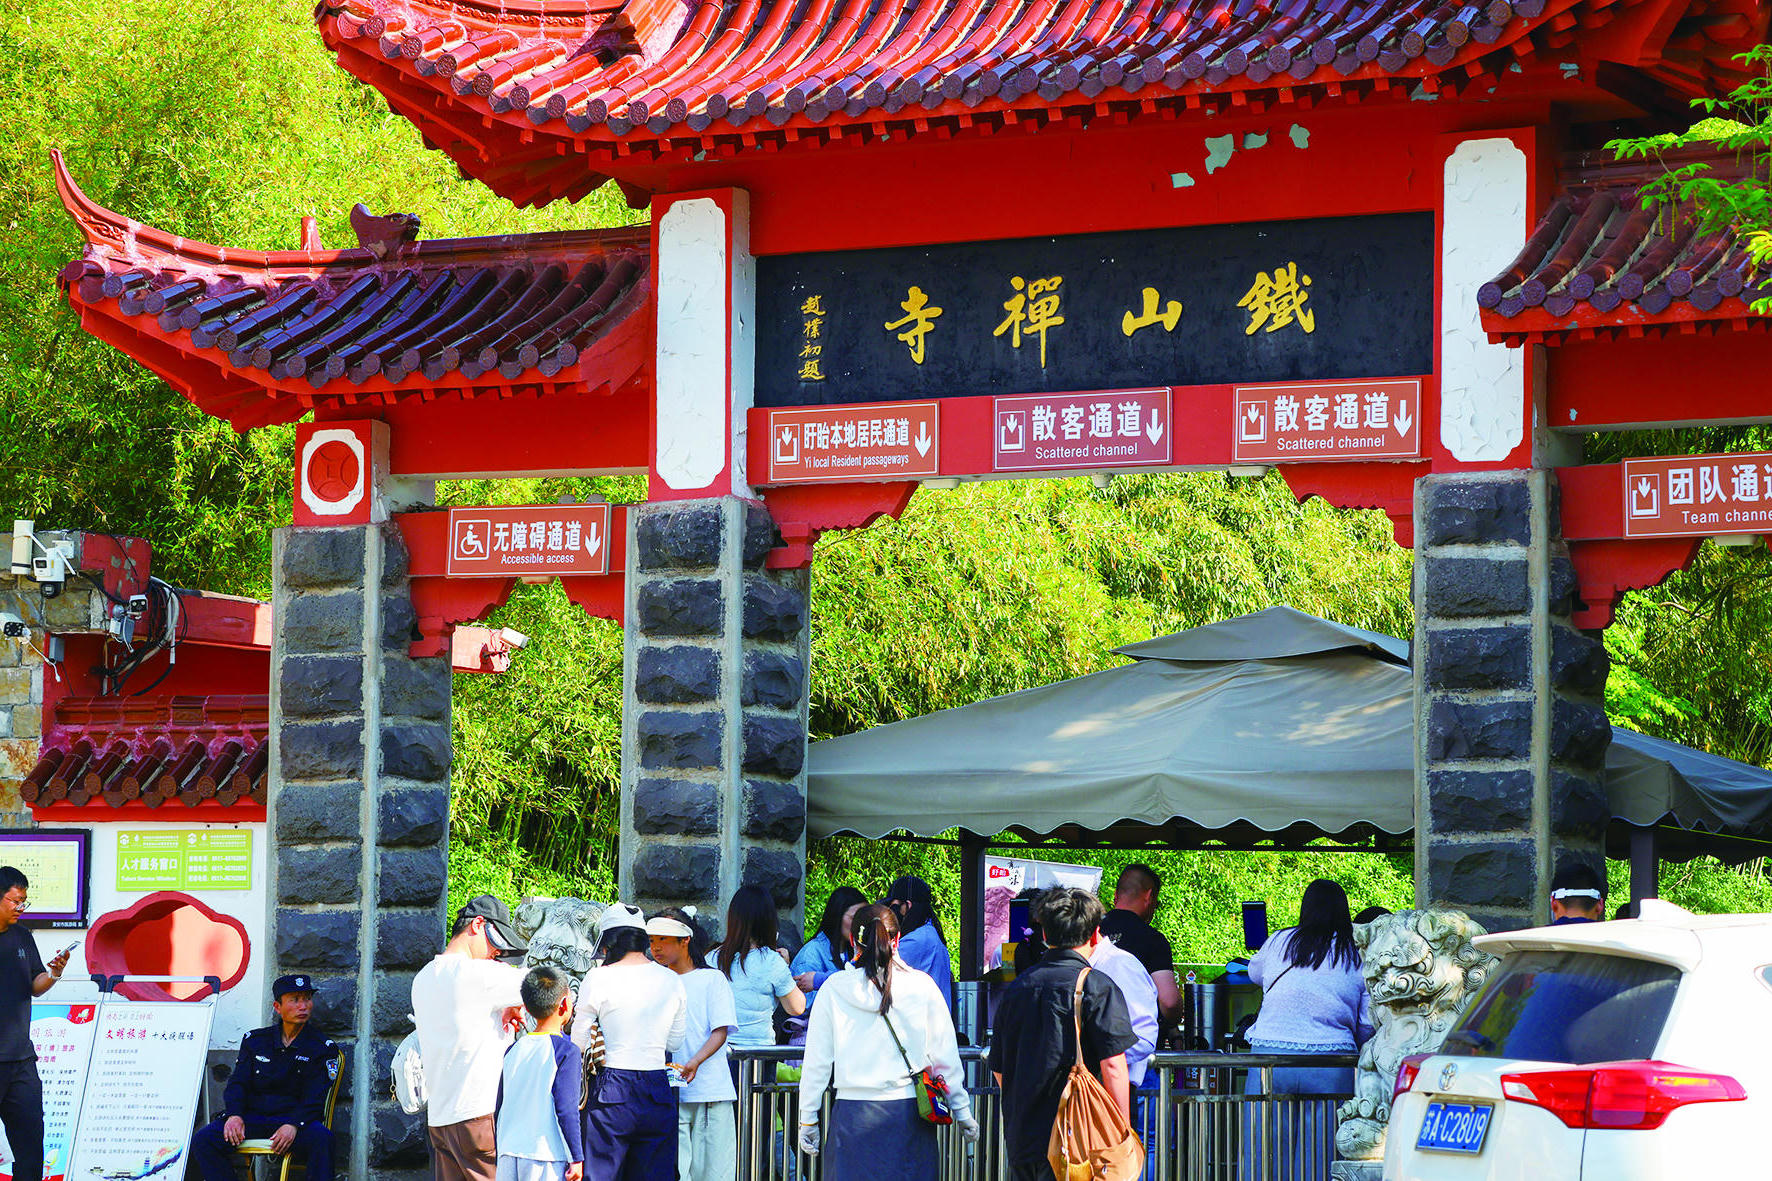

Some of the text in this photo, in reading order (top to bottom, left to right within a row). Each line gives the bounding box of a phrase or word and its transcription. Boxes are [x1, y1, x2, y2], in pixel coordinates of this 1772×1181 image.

[1031, 401, 1142, 441] 散客通道
[1274, 392, 1389, 432] 散客通道
[803, 418, 910, 450] 盱眙本地居民通道
[1277, 434, 1385, 450] Scattered channel
[1035, 442, 1138, 460] Scattered channel
[804, 454, 909, 469] Yi local Resident passageways
[1681, 510, 1719, 524] Team
[493, 521, 582, 552] 无障碍通道
[501, 553, 575, 565] Accessible access
